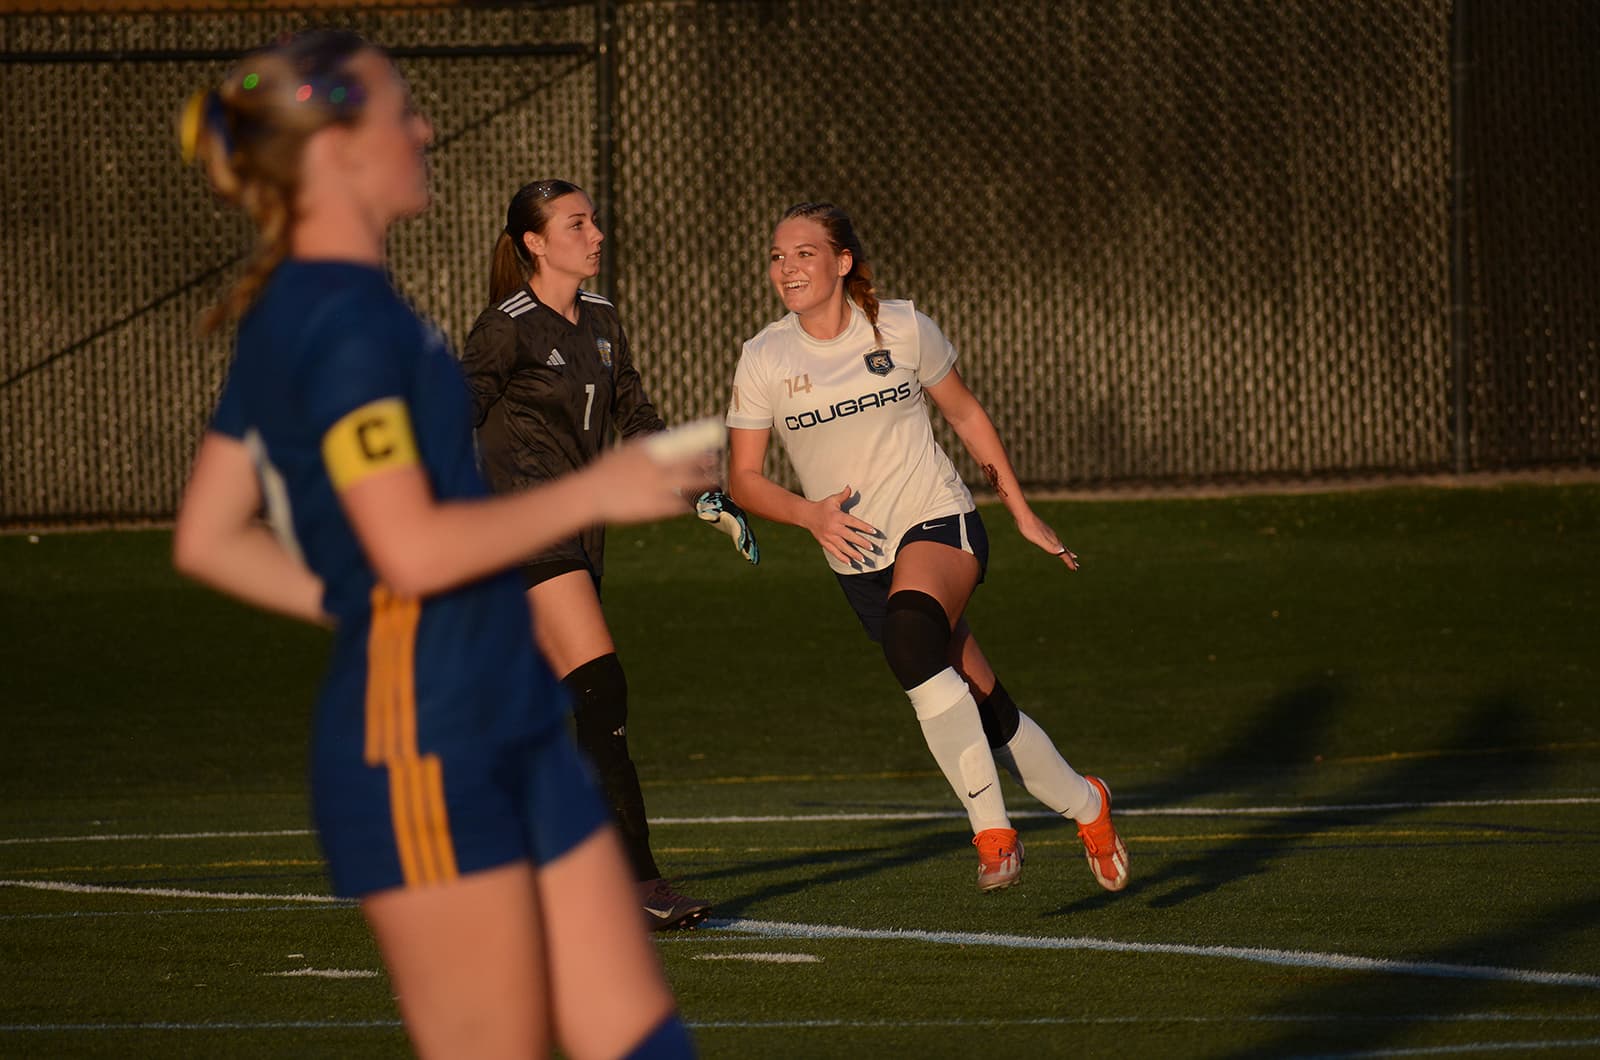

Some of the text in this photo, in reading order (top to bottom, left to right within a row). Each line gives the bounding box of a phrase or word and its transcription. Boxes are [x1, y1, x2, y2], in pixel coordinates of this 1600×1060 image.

[583, 384, 595, 431] 7
[784, 373, 813, 399] 14
[785, 381, 911, 431] COUGARS
[357, 418, 393, 461] C
